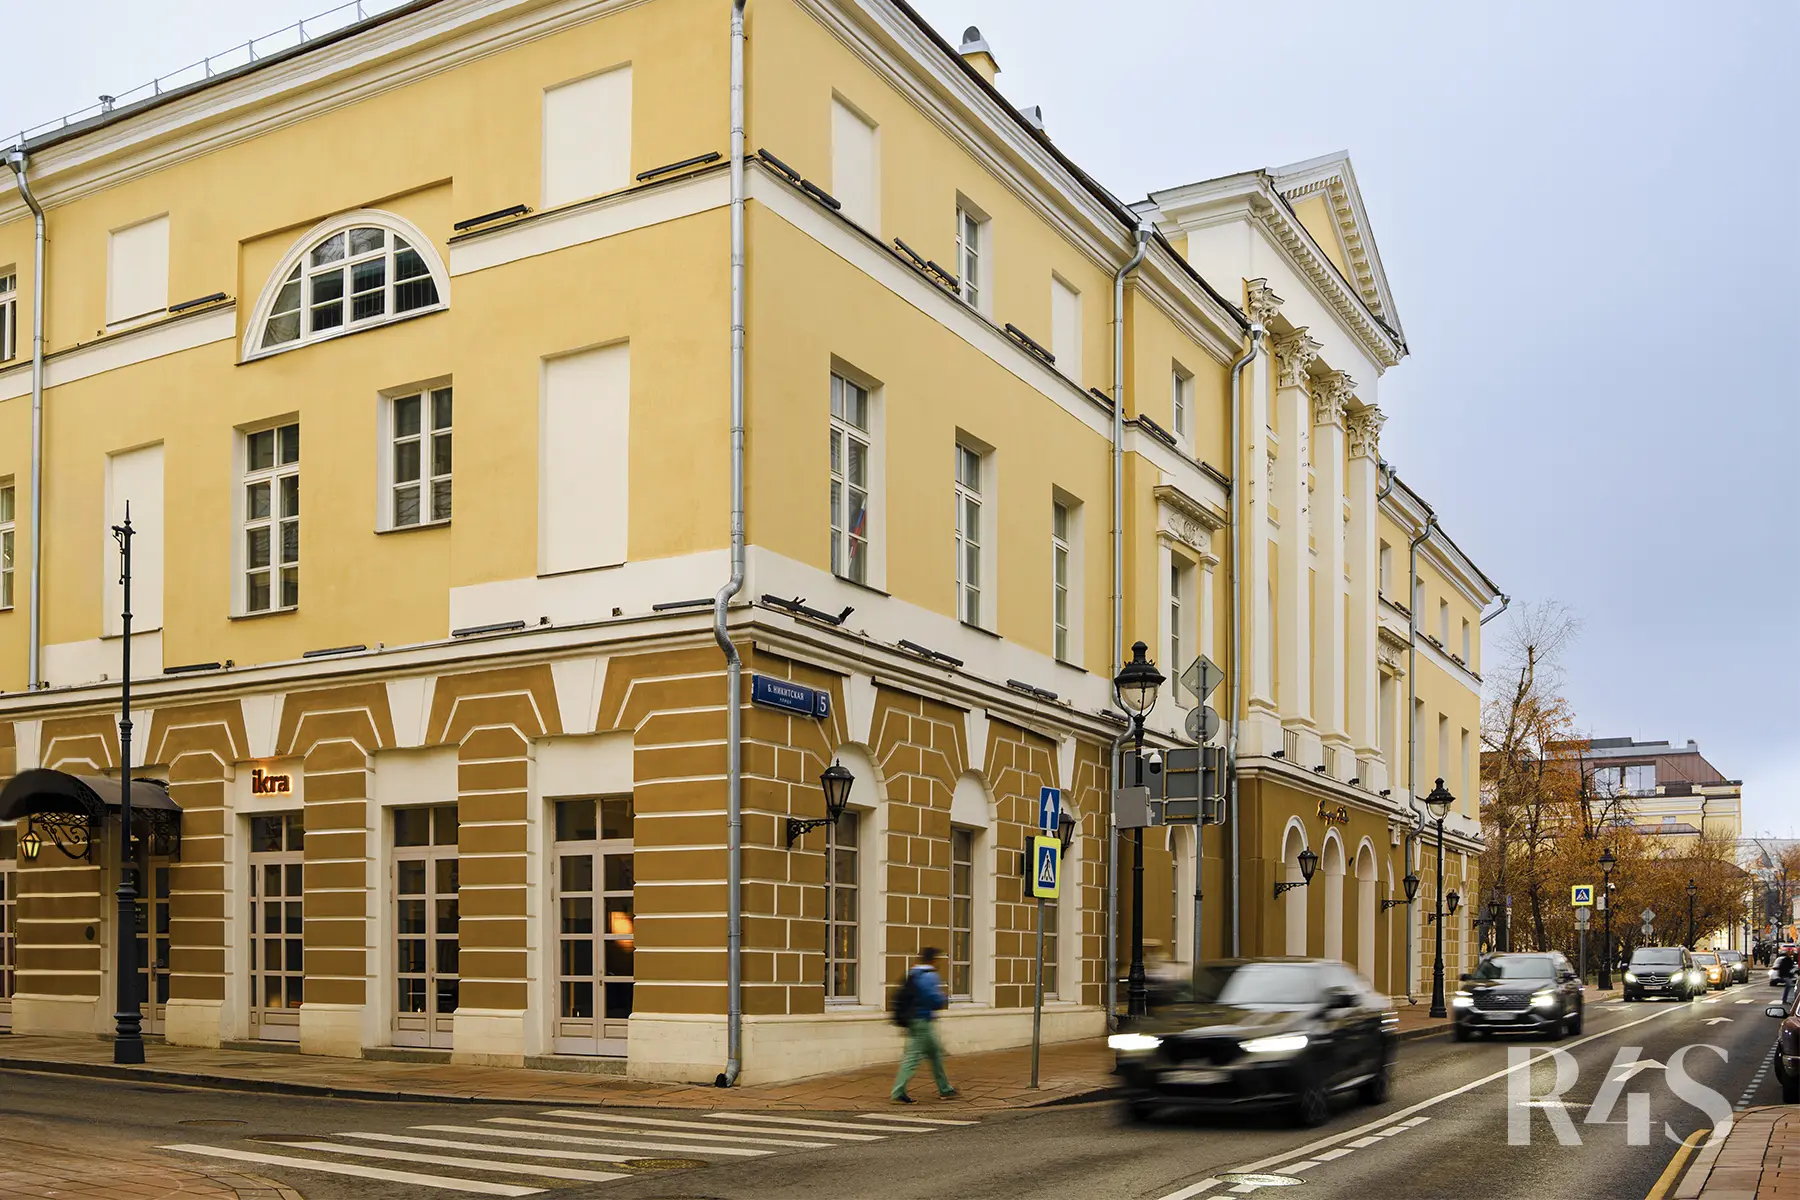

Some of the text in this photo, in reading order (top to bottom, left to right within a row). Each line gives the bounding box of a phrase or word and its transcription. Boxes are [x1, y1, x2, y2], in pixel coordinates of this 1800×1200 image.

[767, 684, 804, 700] Б. НИКИТСКАЯ
[820, 696, 827, 712] 5
[252, 769, 290, 793] ikra
